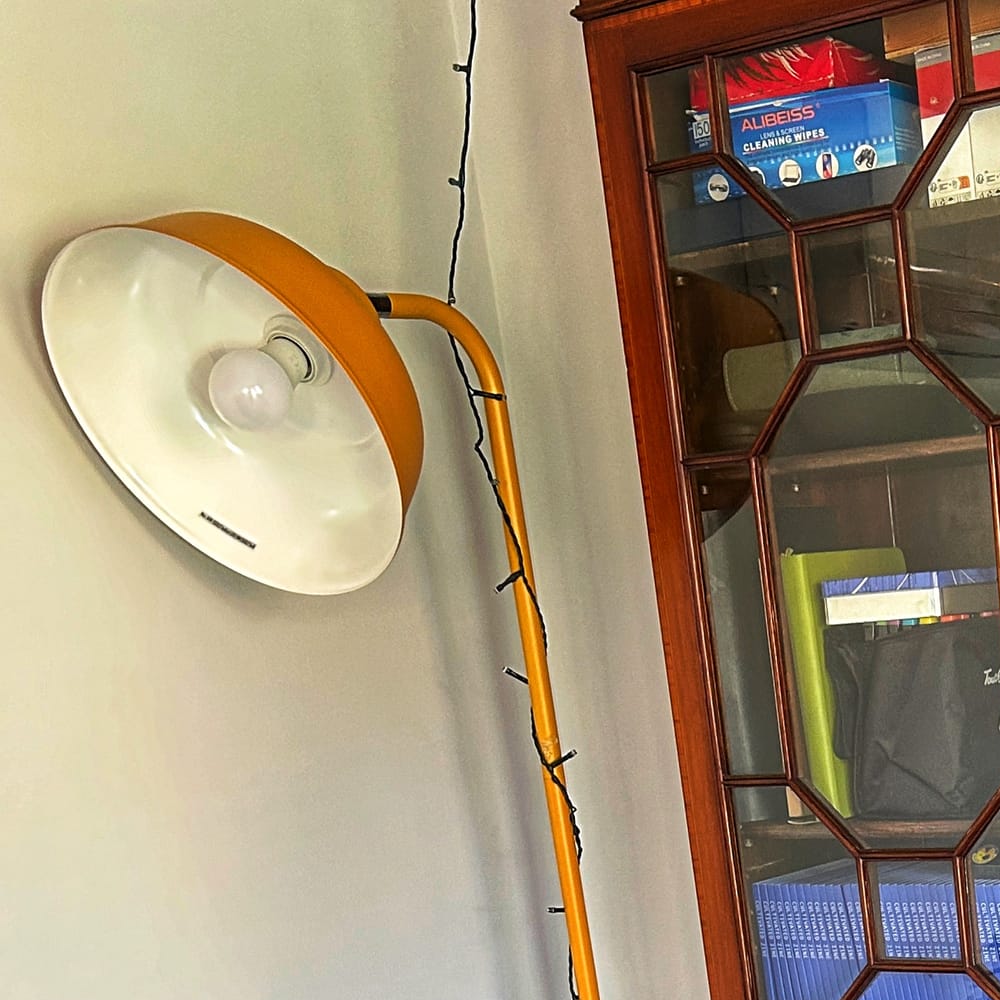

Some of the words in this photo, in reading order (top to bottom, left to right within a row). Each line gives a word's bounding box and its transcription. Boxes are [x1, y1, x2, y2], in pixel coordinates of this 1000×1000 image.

[694, 120, 710, 137] 150
[742, 105, 815, 132] ALIBEISS
[744, 133, 792, 152] CLEANING
[794, 128, 825, 141] WIPES
[760, 131, 776, 140] LENS
[780, 126, 805, 136] SCREEN
[981, 903, 993, 943] CULTIVATED
